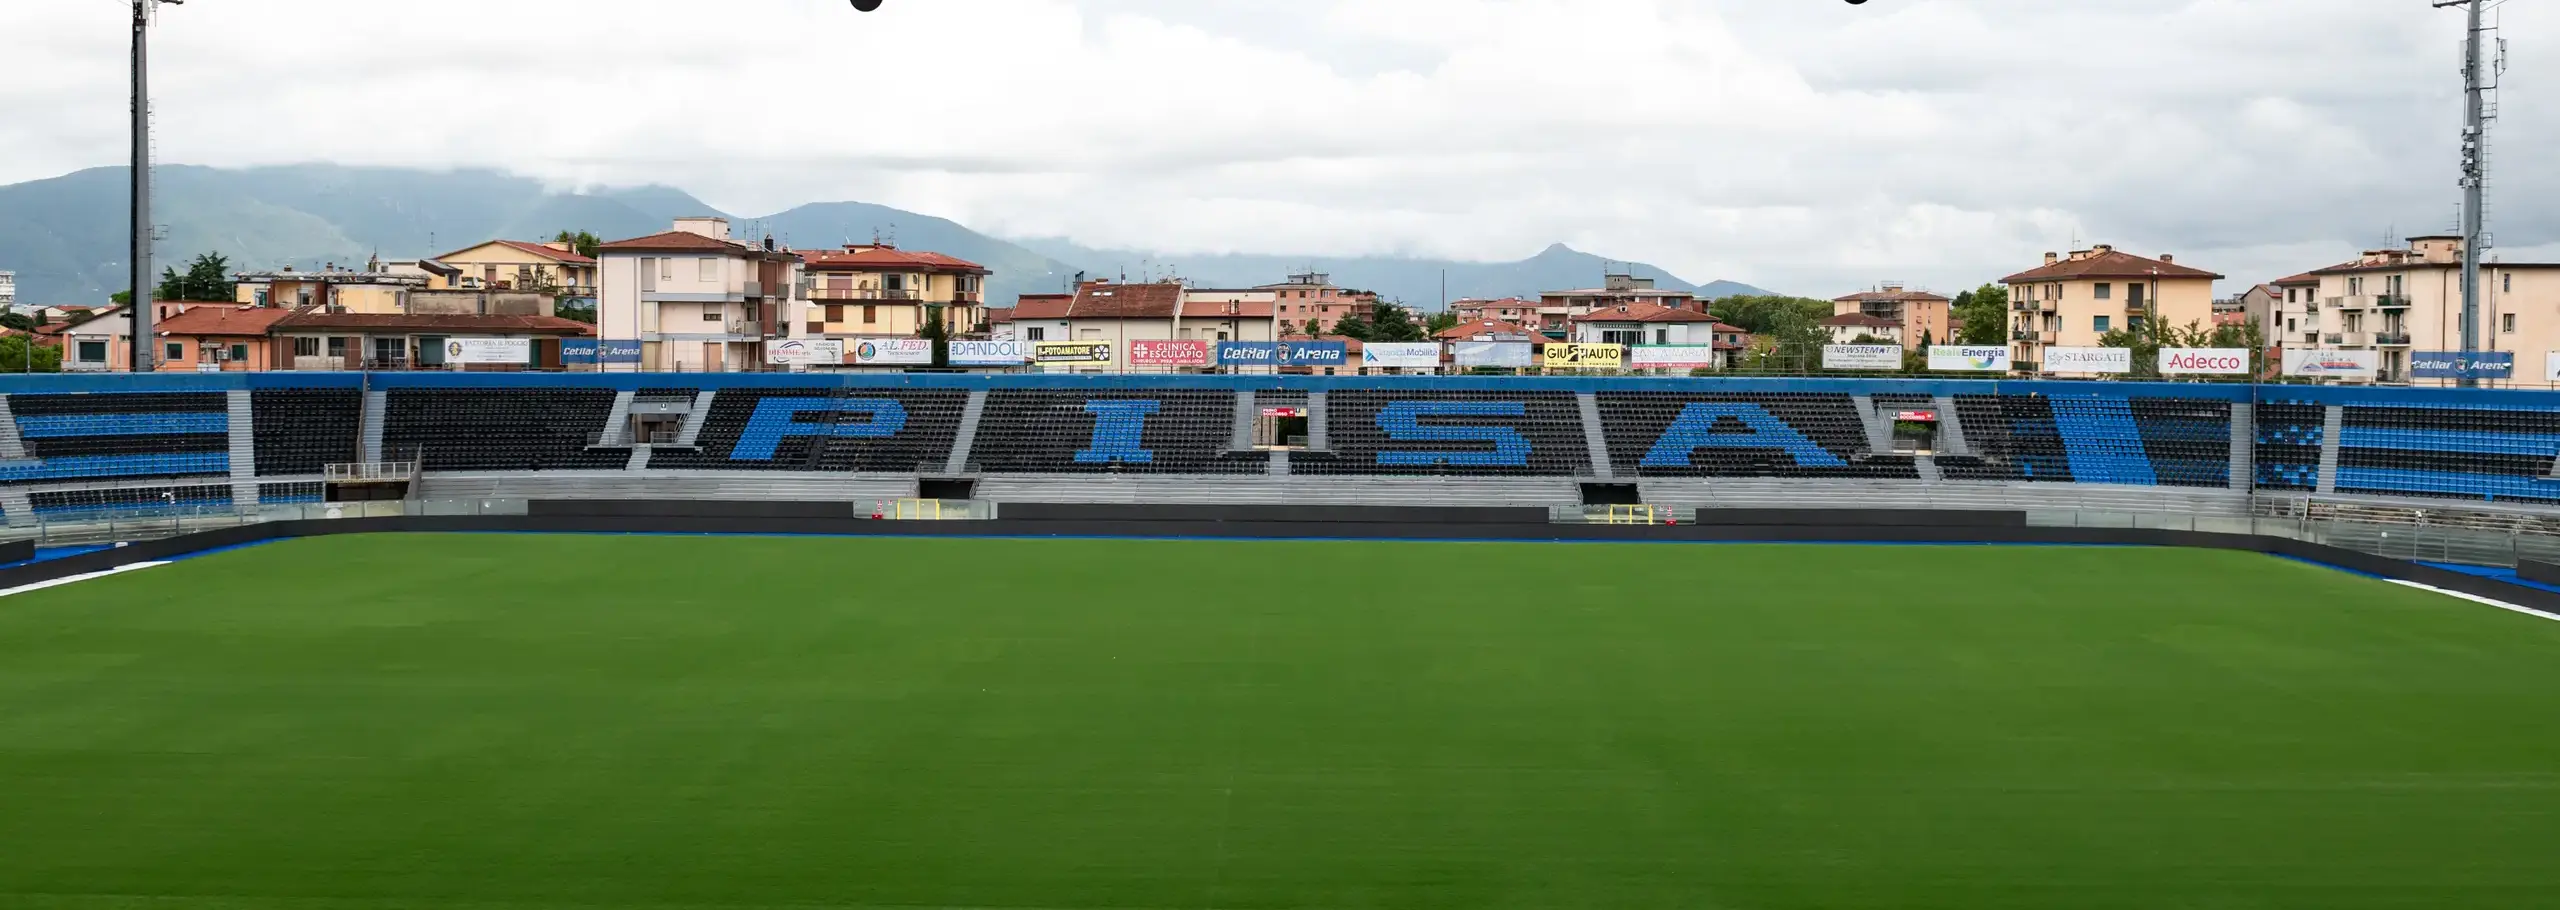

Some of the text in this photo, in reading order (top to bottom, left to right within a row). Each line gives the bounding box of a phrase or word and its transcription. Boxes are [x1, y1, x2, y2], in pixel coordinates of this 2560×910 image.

[563, 347, 641, 356] Cetilar Arena
[955, 342, 1022, 356] DANDOLI
[1045, 346, 1091, 356] FOTOAMATORE
[1156, 345, 1196, 353] CLINICA
[1223, 347, 1340, 359] Cetilar Arena
[1633, 347, 1669, 357] SANA
[1149, 352, 1204, 360] ESCULAPIO
[2064, 352, 2126, 363] STARGATE
[2168, 352, 2240, 369] Adecco
[2413, 360, 2452, 369] Cetilar
